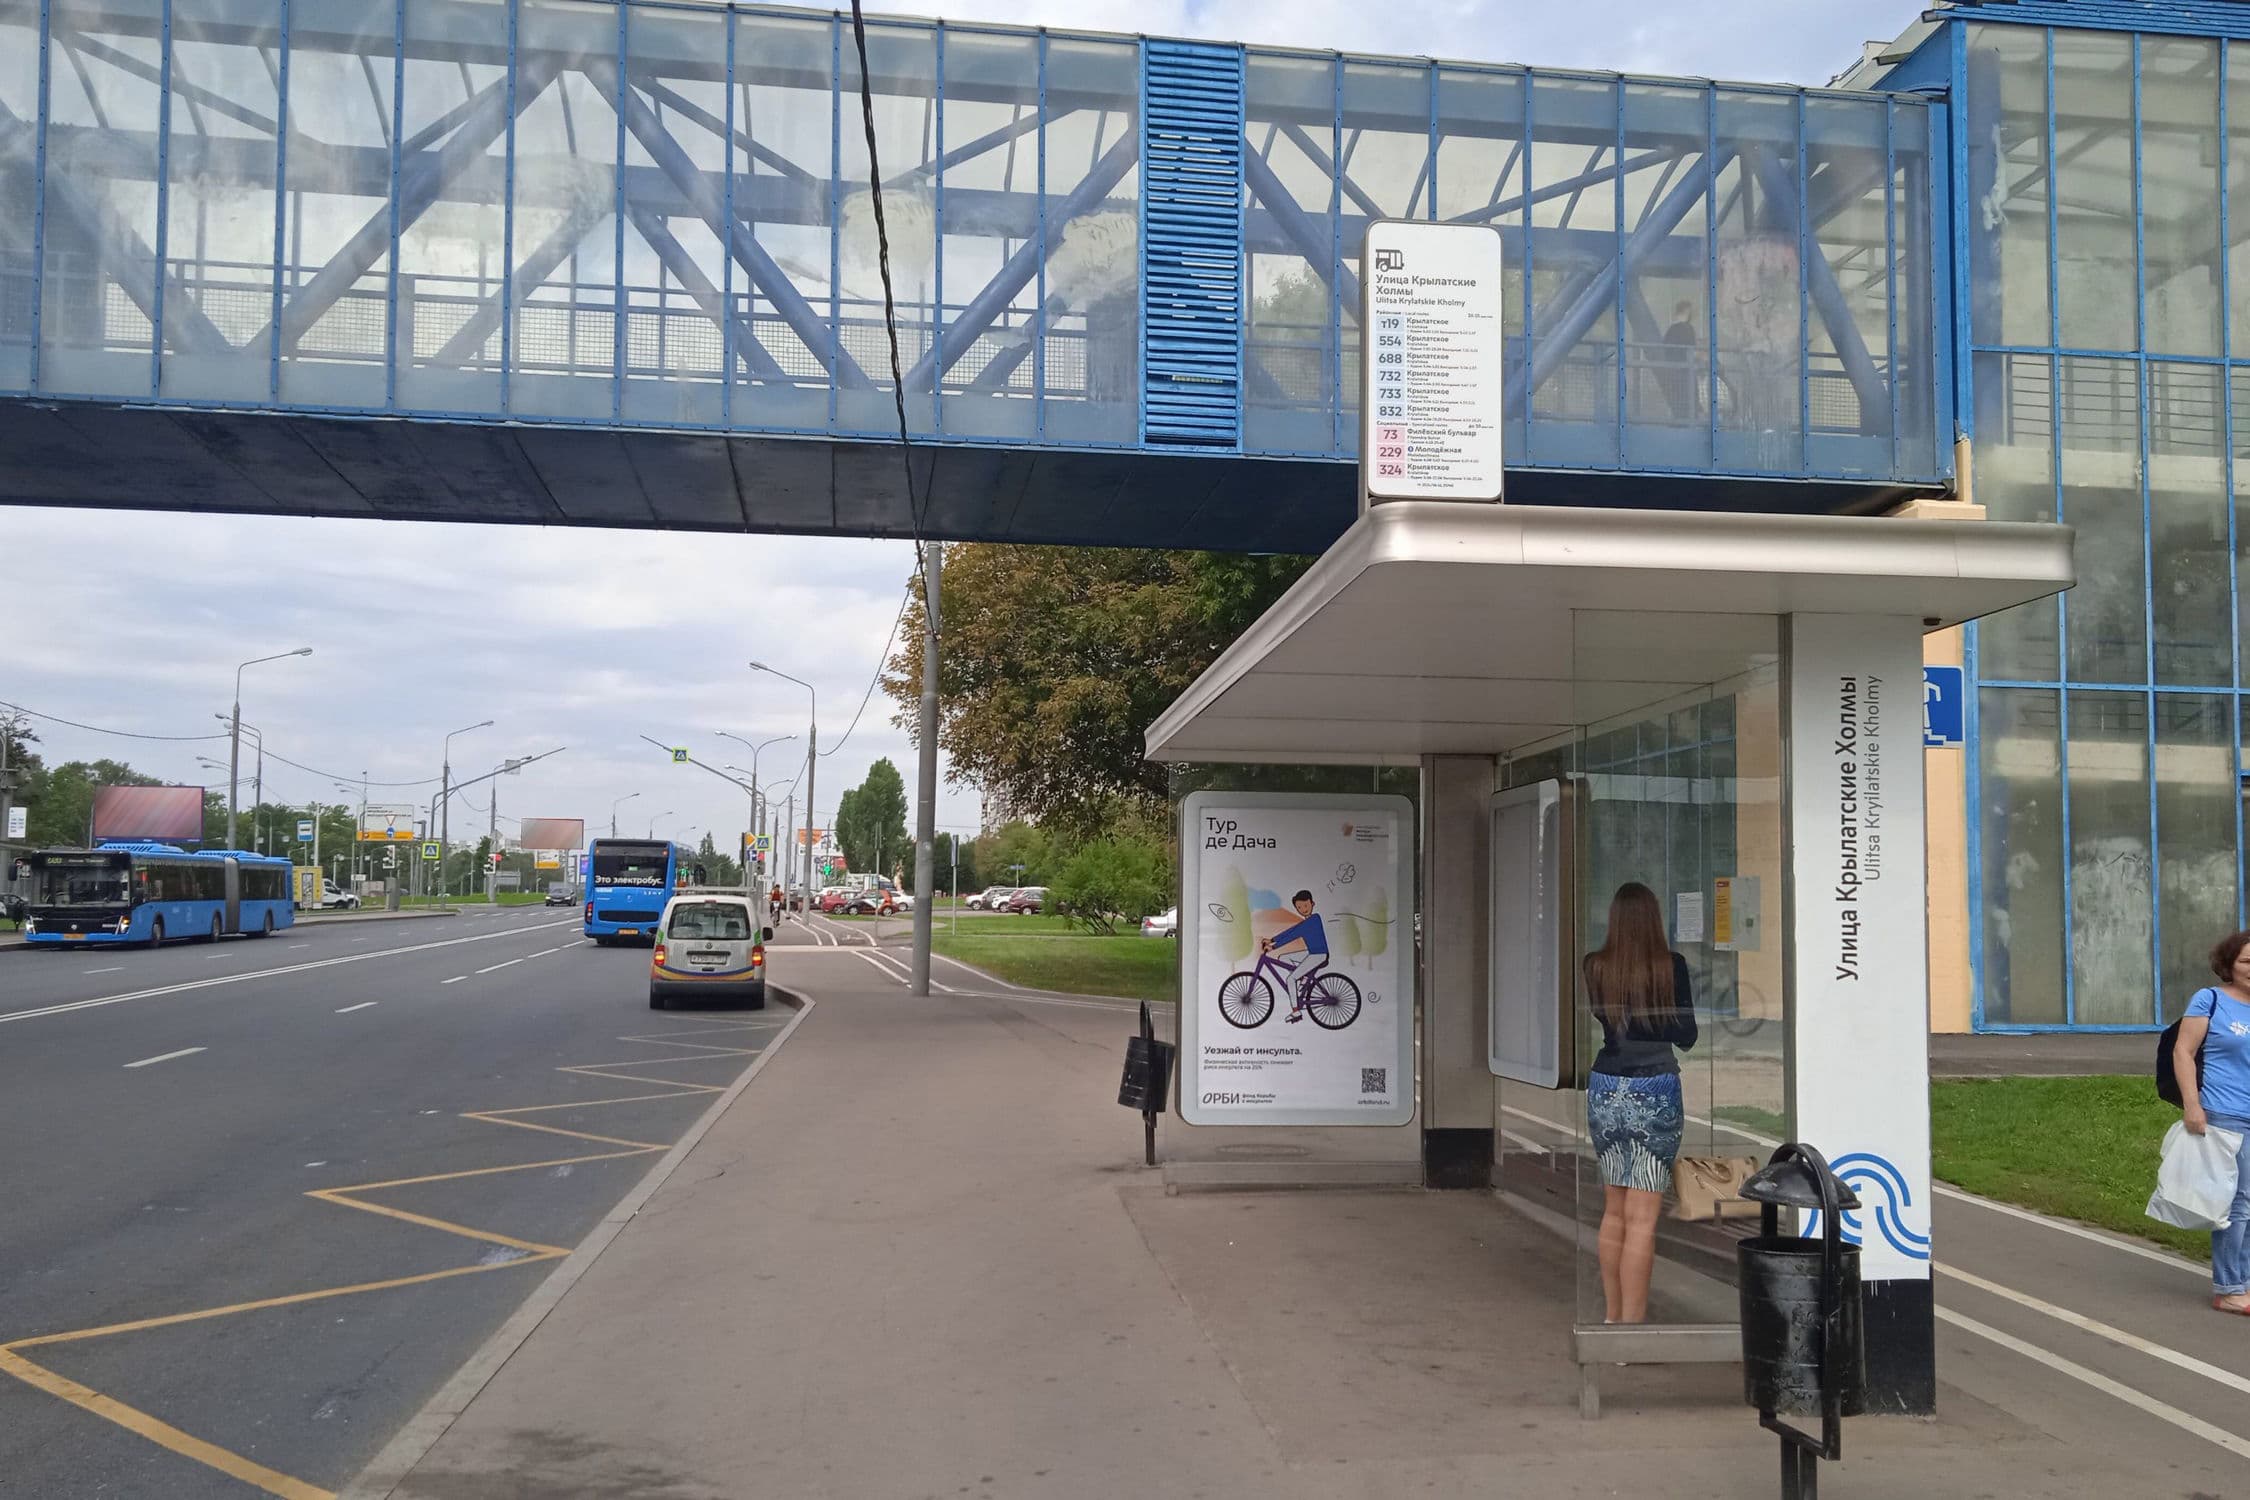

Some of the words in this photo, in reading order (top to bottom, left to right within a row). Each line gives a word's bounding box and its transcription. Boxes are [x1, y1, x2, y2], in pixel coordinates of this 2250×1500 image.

[1376, 274, 1409, 286] Улица
[1412, 275, 1477, 287] Крылатские
[1376, 285, 1414, 296] Холмы
[1399, 297, 1436, 306] Krylatskie
[1438, 298, 1466, 307] Kholmy
[1381, 318, 1400, 329] т19
[1406, 317, 1449, 325] Крылатское
[1379, 336, 1402, 346] 554
[1378, 353, 1402, 364] 688
[1406, 352, 1449, 360] Крылатское
[1379, 371, 1401, 381] 732
[1407, 370, 1450, 378] Крылатское
[1379, 388, 1401, 399] 733
[1379, 406, 1402, 417] 832
[1407, 405, 1450, 413] Крылатское
[1383, 429, 1398, 440] 73
[1447, 429, 1477, 437] бульвар
[1379, 447, 1402, 457] 229
[1415, 446, 1462, 454] Молодёжная
[1379, 465, 1402, 475] 324
[1407, 463, 1450, 471] Крылатское
[1863, 675, 1883, 737] Kholmy
[1835, 676, 1857, 756] Холмы
[1864, 742, 1883, 829] Kryilatskie
[1206, 817, 1238, 834] Тур
[1835, 761, 1863, 902] Крылатские
[1205, 836, 1228, 849] де
[1232, 834, 1277, 850] Дача
[1864, 834, 1880, 880] Ulitsa
[595, 875, 612, 884] Это
[613, 875, 664, 886] электробус.
[1836, 910, 1861, 981] Улица
[1204, 1046, 1241, 1055] Уезжай
[1256, 1048, 1303, 1056] инсульта.
[1202, 1092, 1240, 1104] ОРБИ
